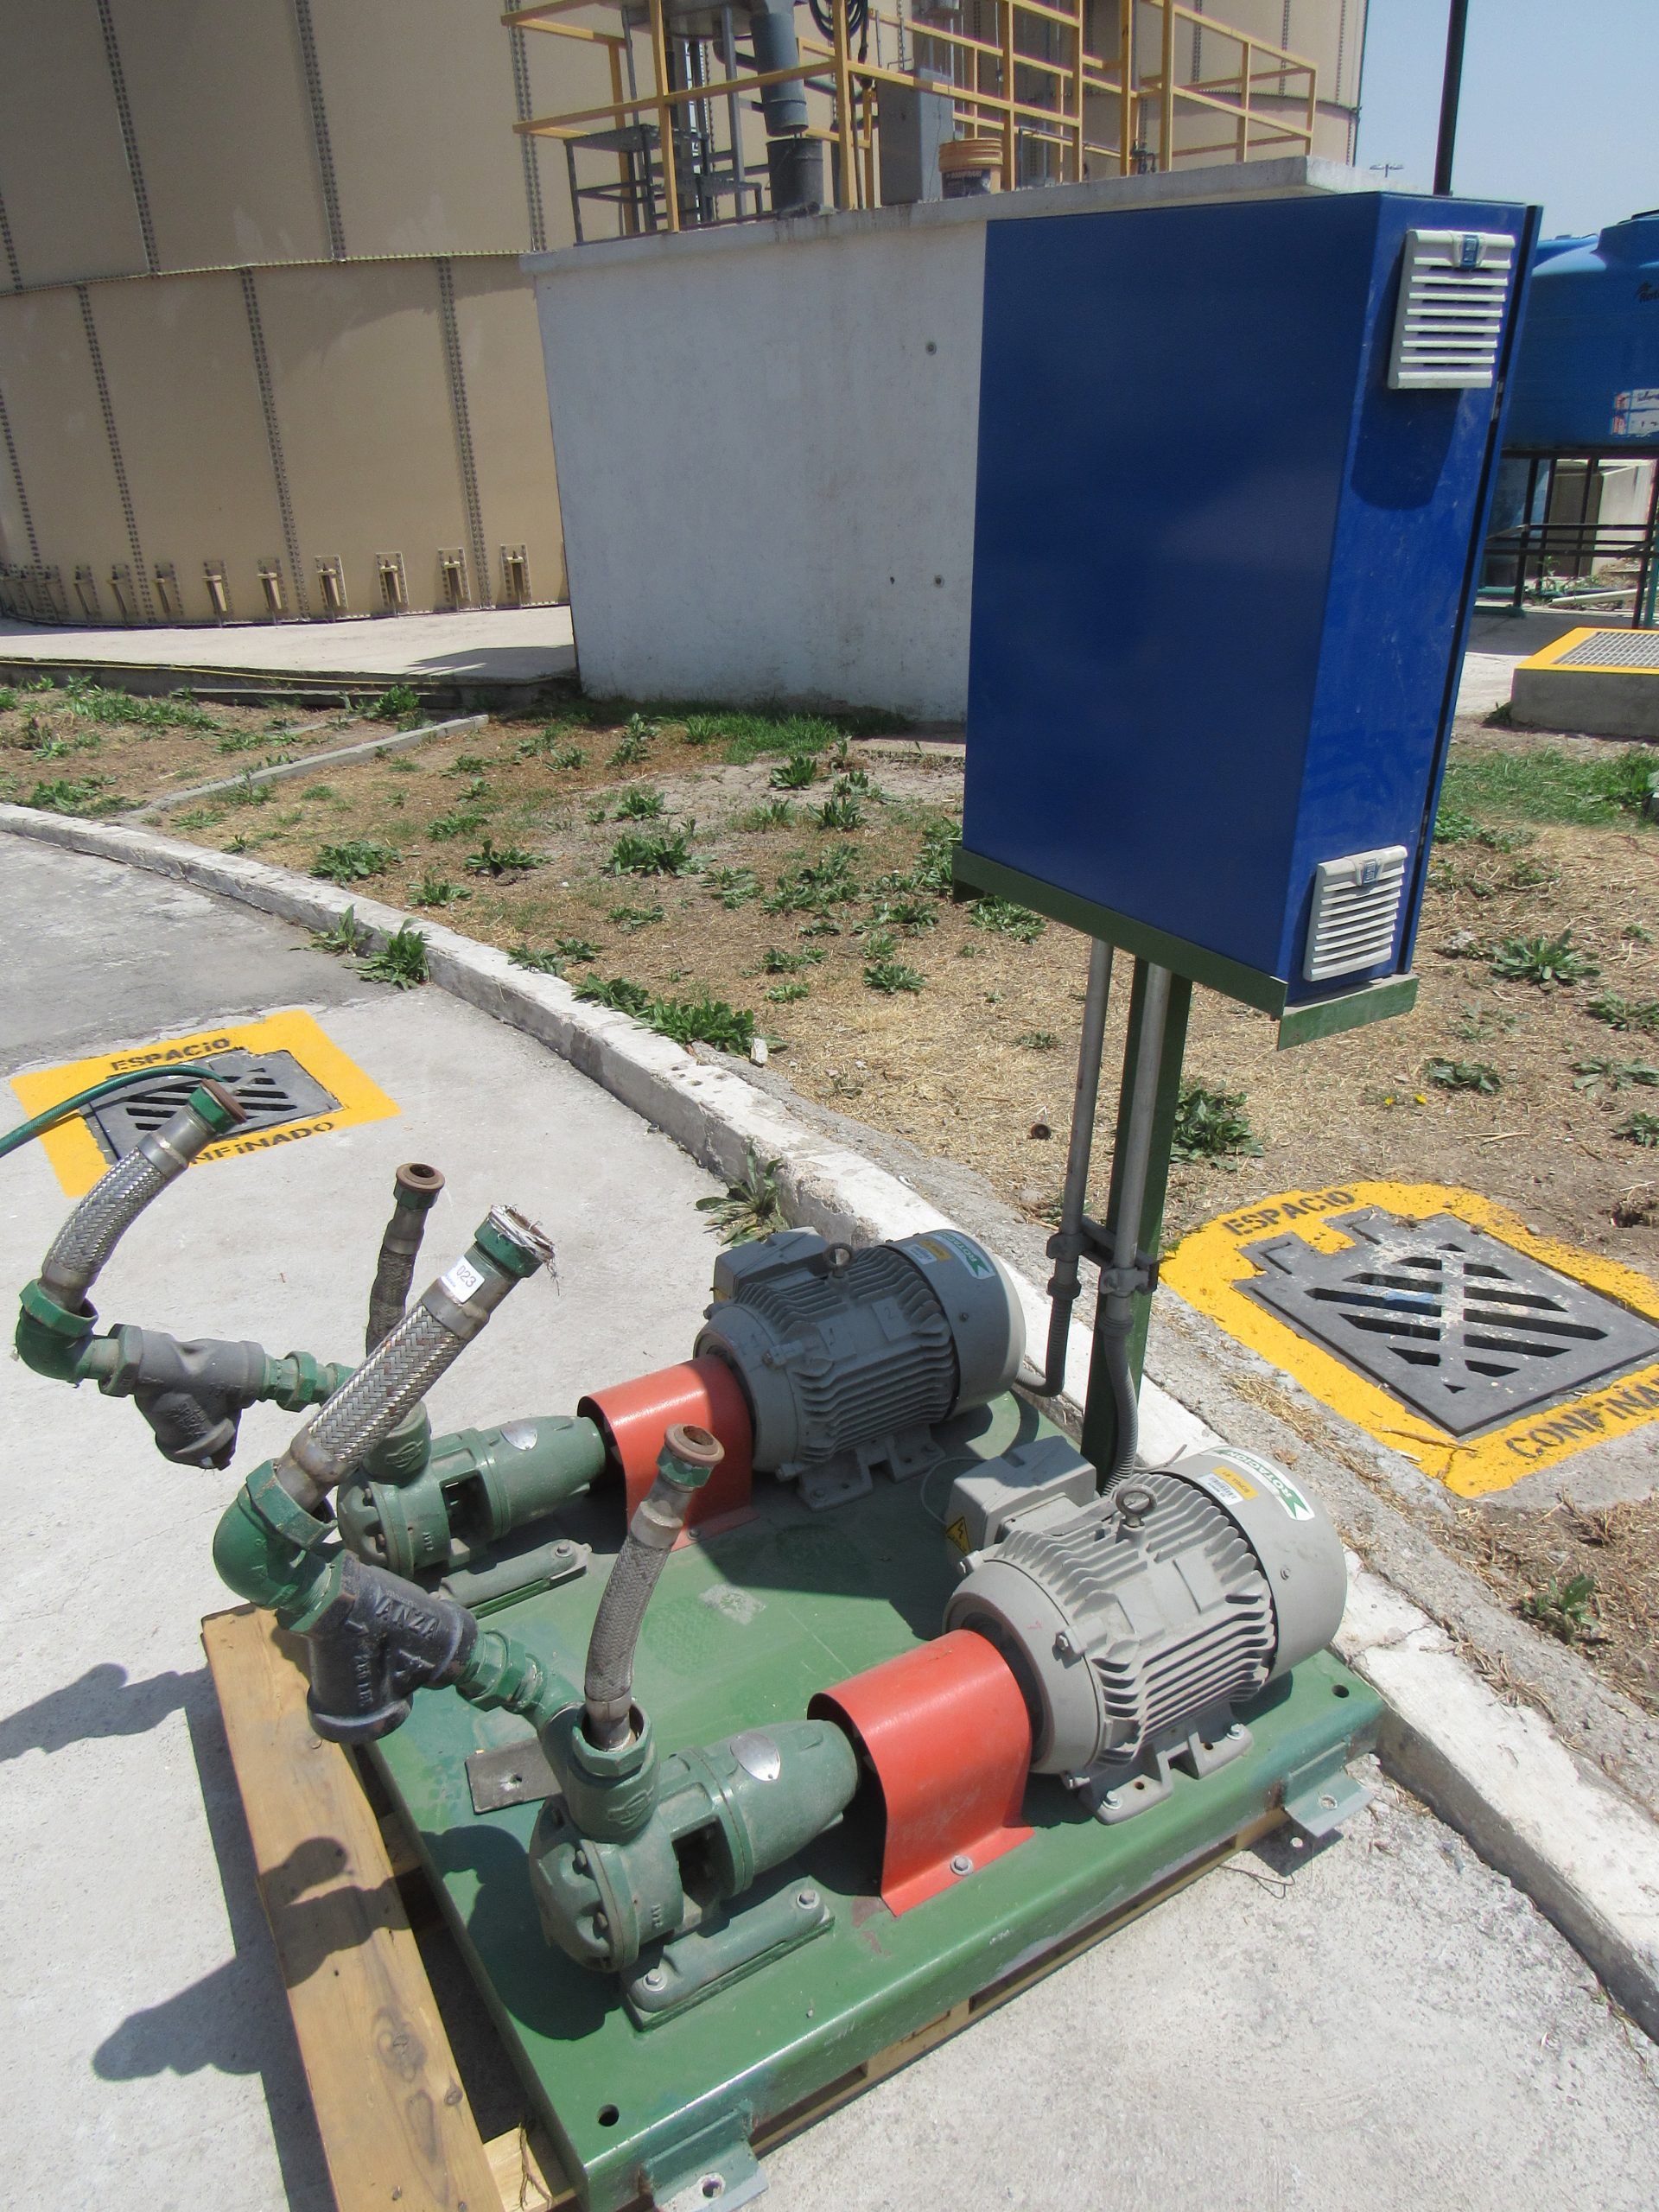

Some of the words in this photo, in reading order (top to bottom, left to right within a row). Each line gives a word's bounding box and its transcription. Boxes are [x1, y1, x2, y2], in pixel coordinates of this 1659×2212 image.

[190, 1122, 334, 1165] NFiNADO
[456, 1265, 477, 1287] 023
[1505, 1378, 1659, 1459] CONFiNA
[1227, 1451, 1294, 1498] ROTACION
